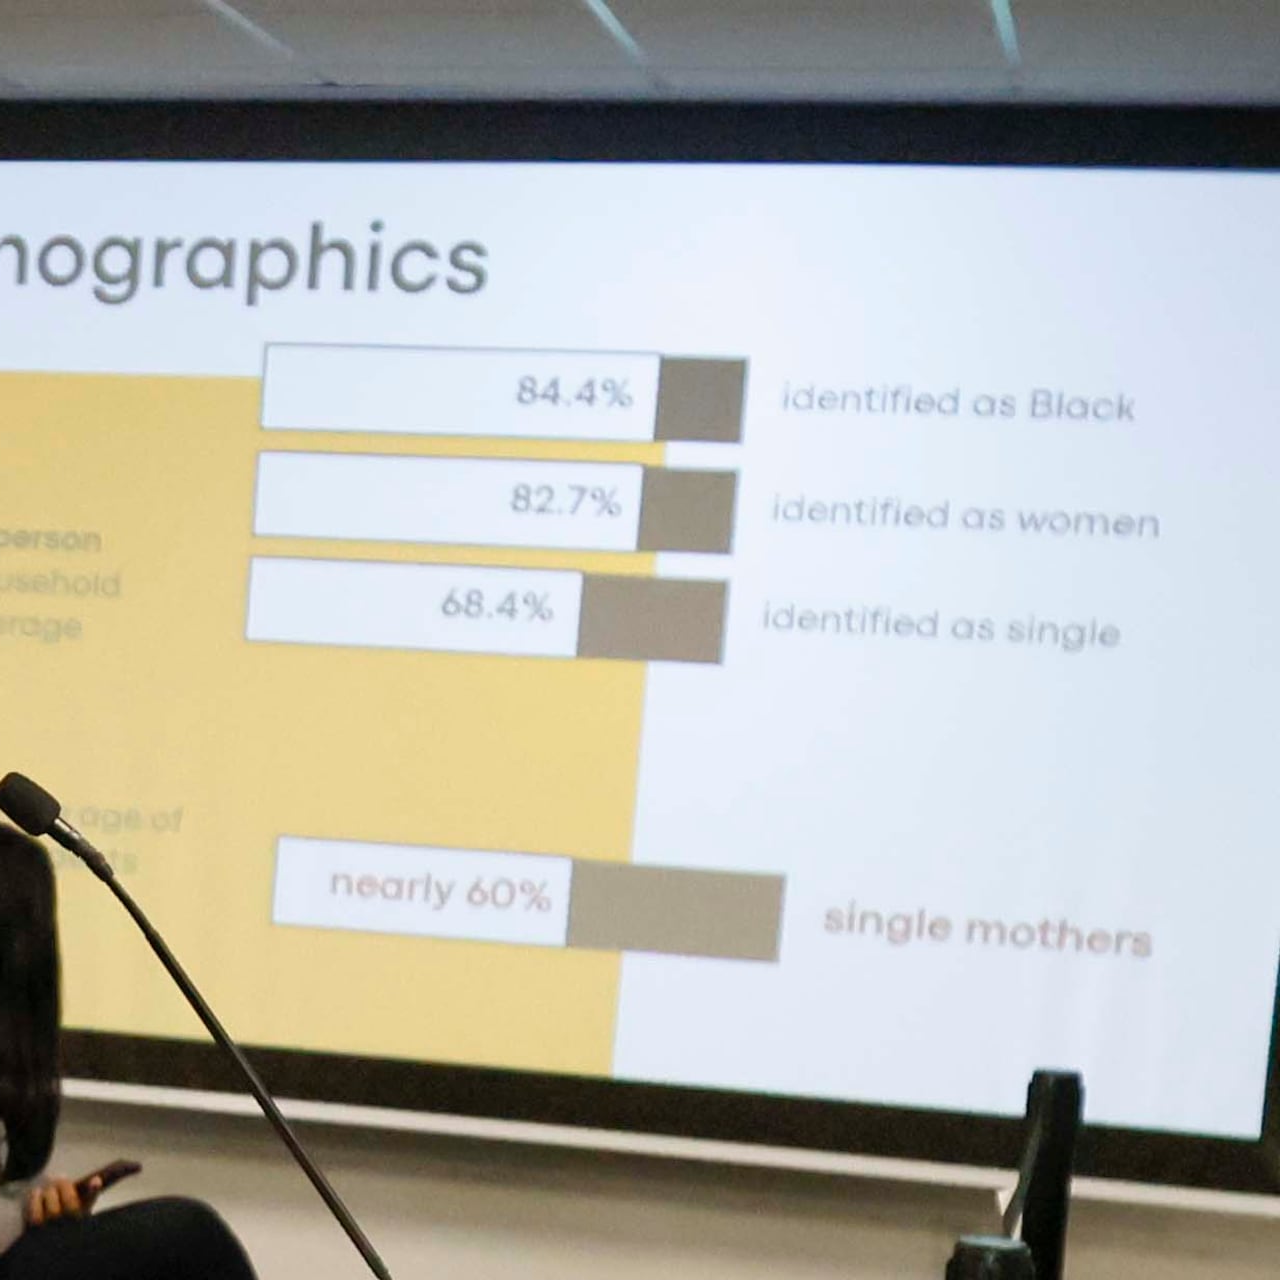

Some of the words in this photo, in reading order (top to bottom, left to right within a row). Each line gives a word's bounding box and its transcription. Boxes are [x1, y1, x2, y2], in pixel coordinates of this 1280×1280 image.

[515, 376, 634, 409] 84.4%
[782, 381, 962, 419] identified
[972, 393, 1017, 419] as
[1029, 387, 1136, 422] Black
[509, 484, 623, 518] 82.7%
[771, 493, 950, 531] identified
[960, 507, 1006, 532] as
[1017, 509, 1161, 540] women
[440, 590, 555, 624] 68.4%
[762, 602, 939, 640] identified
[950, 614, 995, 642] as
[1006, 611, 1121, 654] single
[329, 870, 455, 912] nearly
[466, 876, 552, 913] 60%
[822, 901, 952, 947] single
[966, 916, 1154, 960] mothers
